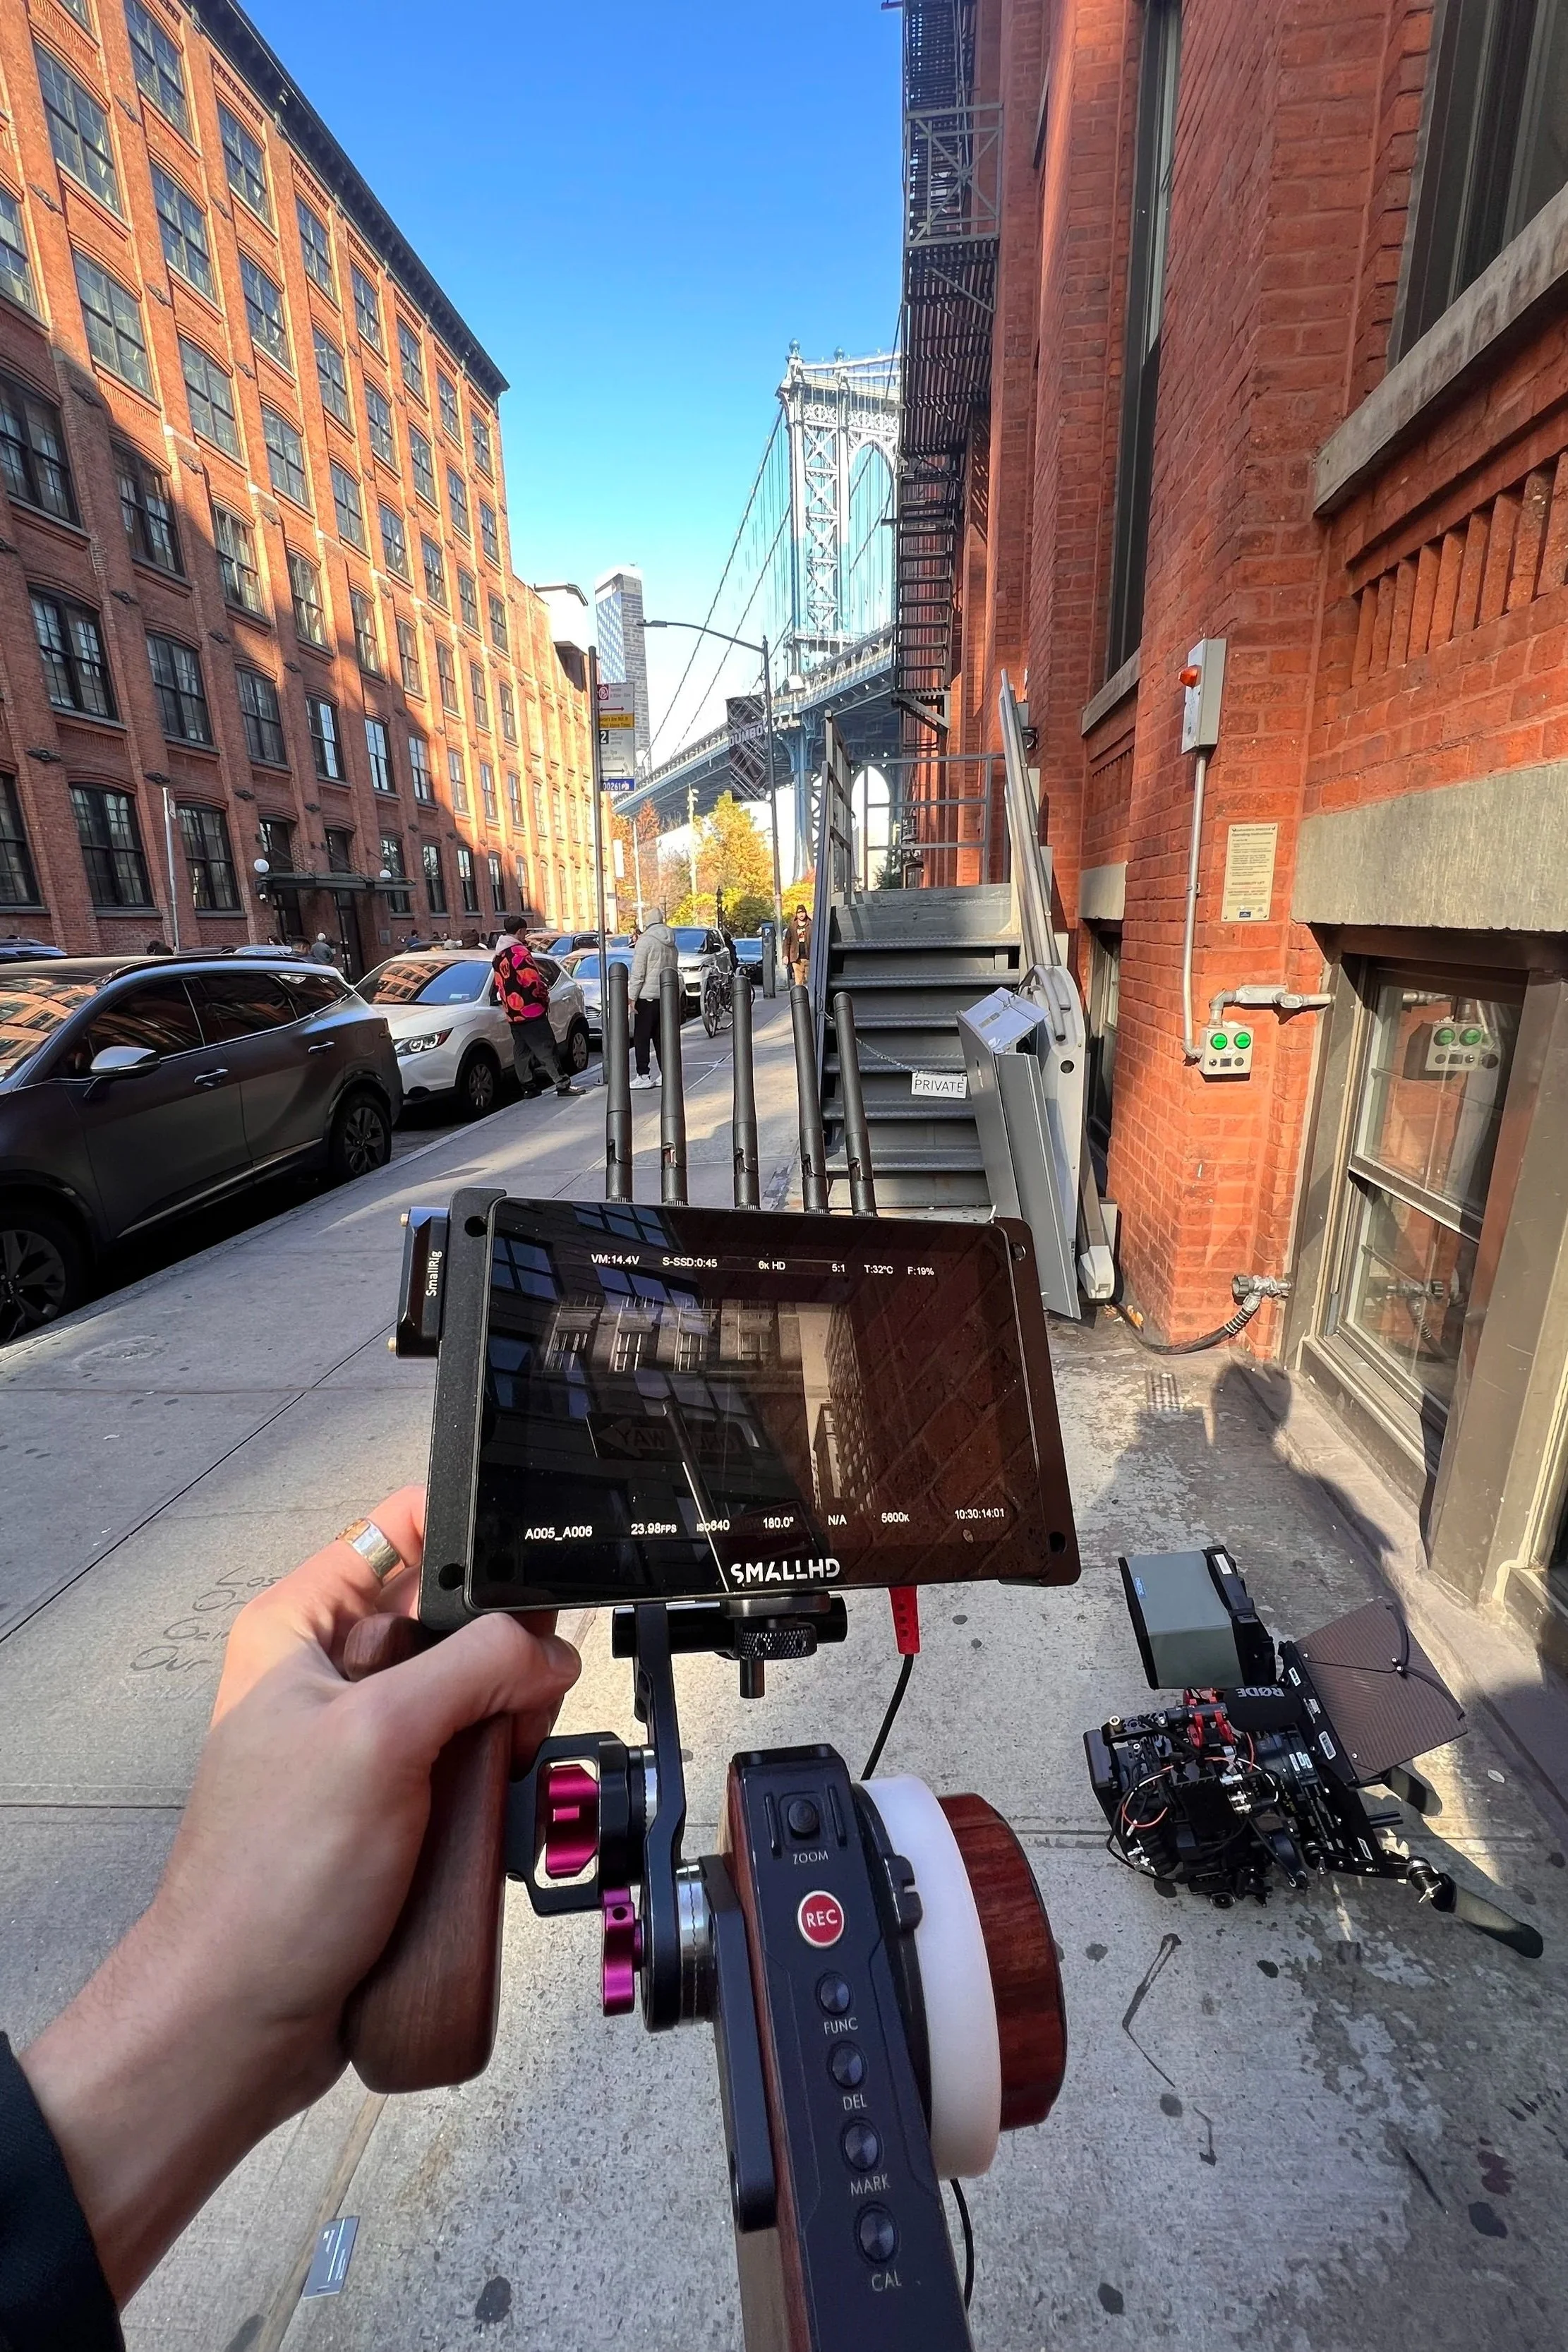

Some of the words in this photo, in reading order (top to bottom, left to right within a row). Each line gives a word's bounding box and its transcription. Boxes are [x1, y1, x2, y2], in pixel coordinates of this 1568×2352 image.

[601, 730, 607, 744] 2
[729, 724, 763, 747] DUMBO
[915, 1079, 964, 1093] PRIVATE
[426, 1250, 442, 1296] SmallRig
[591, 1254, 639, 1265] VM:14.4V
[662, 1257, 718, 1268] S-SSD:0:45
[772, 1261, 786, 1270] HD
[831, 1263, 845, 1272] 5:1
[907, 1266, 934, 1276] F:19%
[828, 1514, 847, 1526] N/A
[955, 1507, 1005, 1519] 10:30:14:01
[730, 1557, 840, 1584] SMALLHD
[130, 1645, 212, 1672] Our
[792, 1850, 828, 1865] ZOOM
[806, 1909, 838, 1928] REC
[824, 2017, 859, 2035] FUNC
[843, 2094, 867, 2111] DEL
[850, 2173, 891, 2196] MARK
[872, 2269, 903, 2292] CAL
